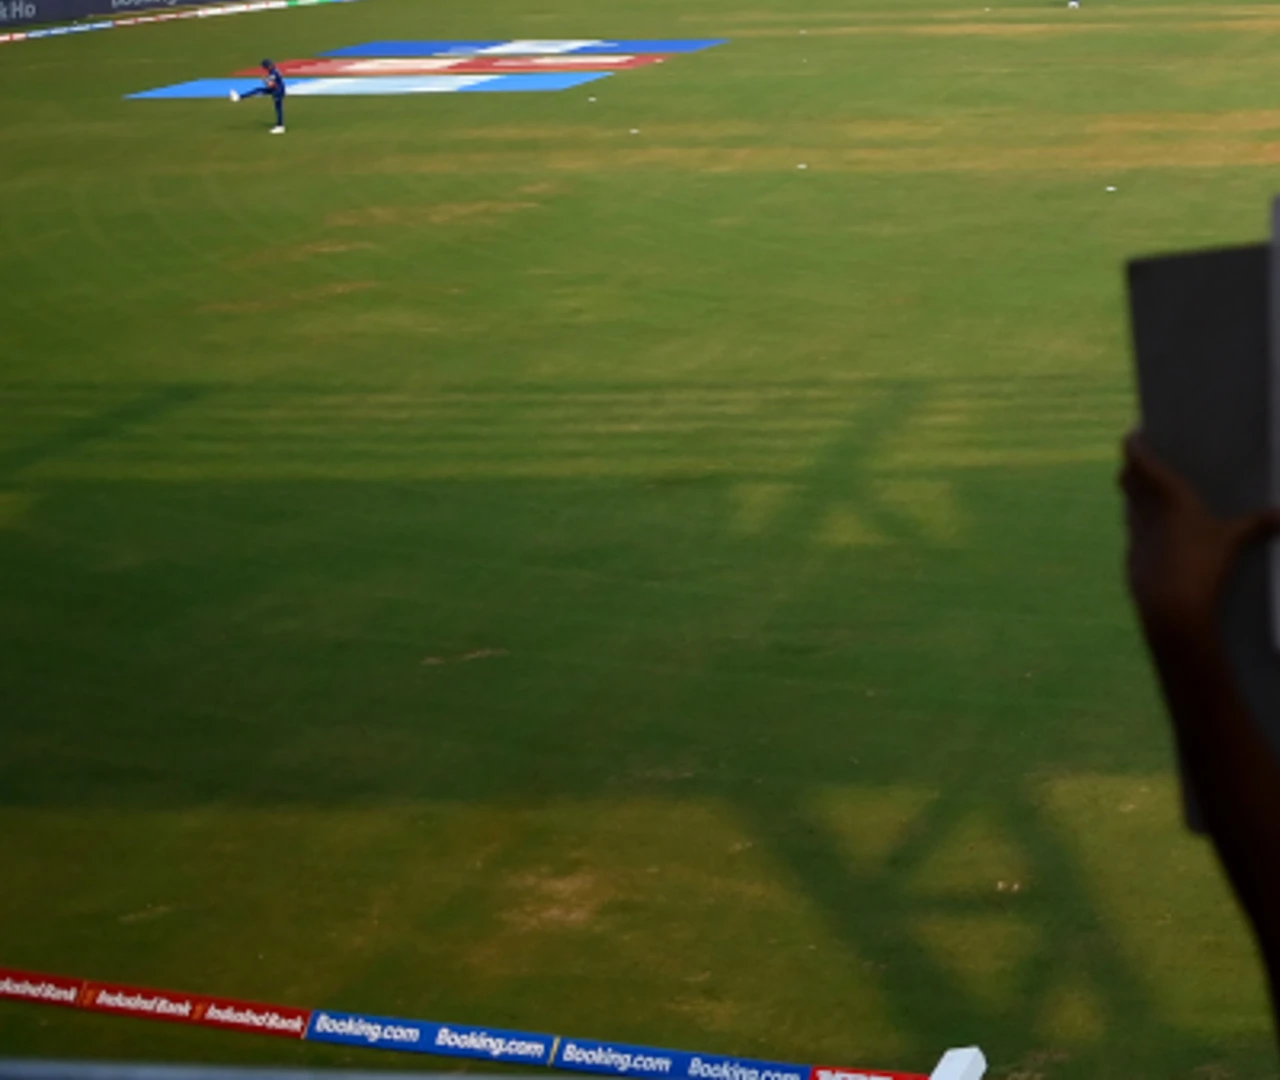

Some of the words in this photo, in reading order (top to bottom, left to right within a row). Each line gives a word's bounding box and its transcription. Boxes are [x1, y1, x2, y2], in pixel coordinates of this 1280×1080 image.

[154, 996, 192, 1017] Bank
[205, 1003, 267, 1027] IndusInd
[265, 1011, 303, 1032] Bank
[316, 1014, 421, 1044] Booking.com
[435, 1027, 546, 1058] Booking.com
[562, 1043, 673, 1074] Booking.com
